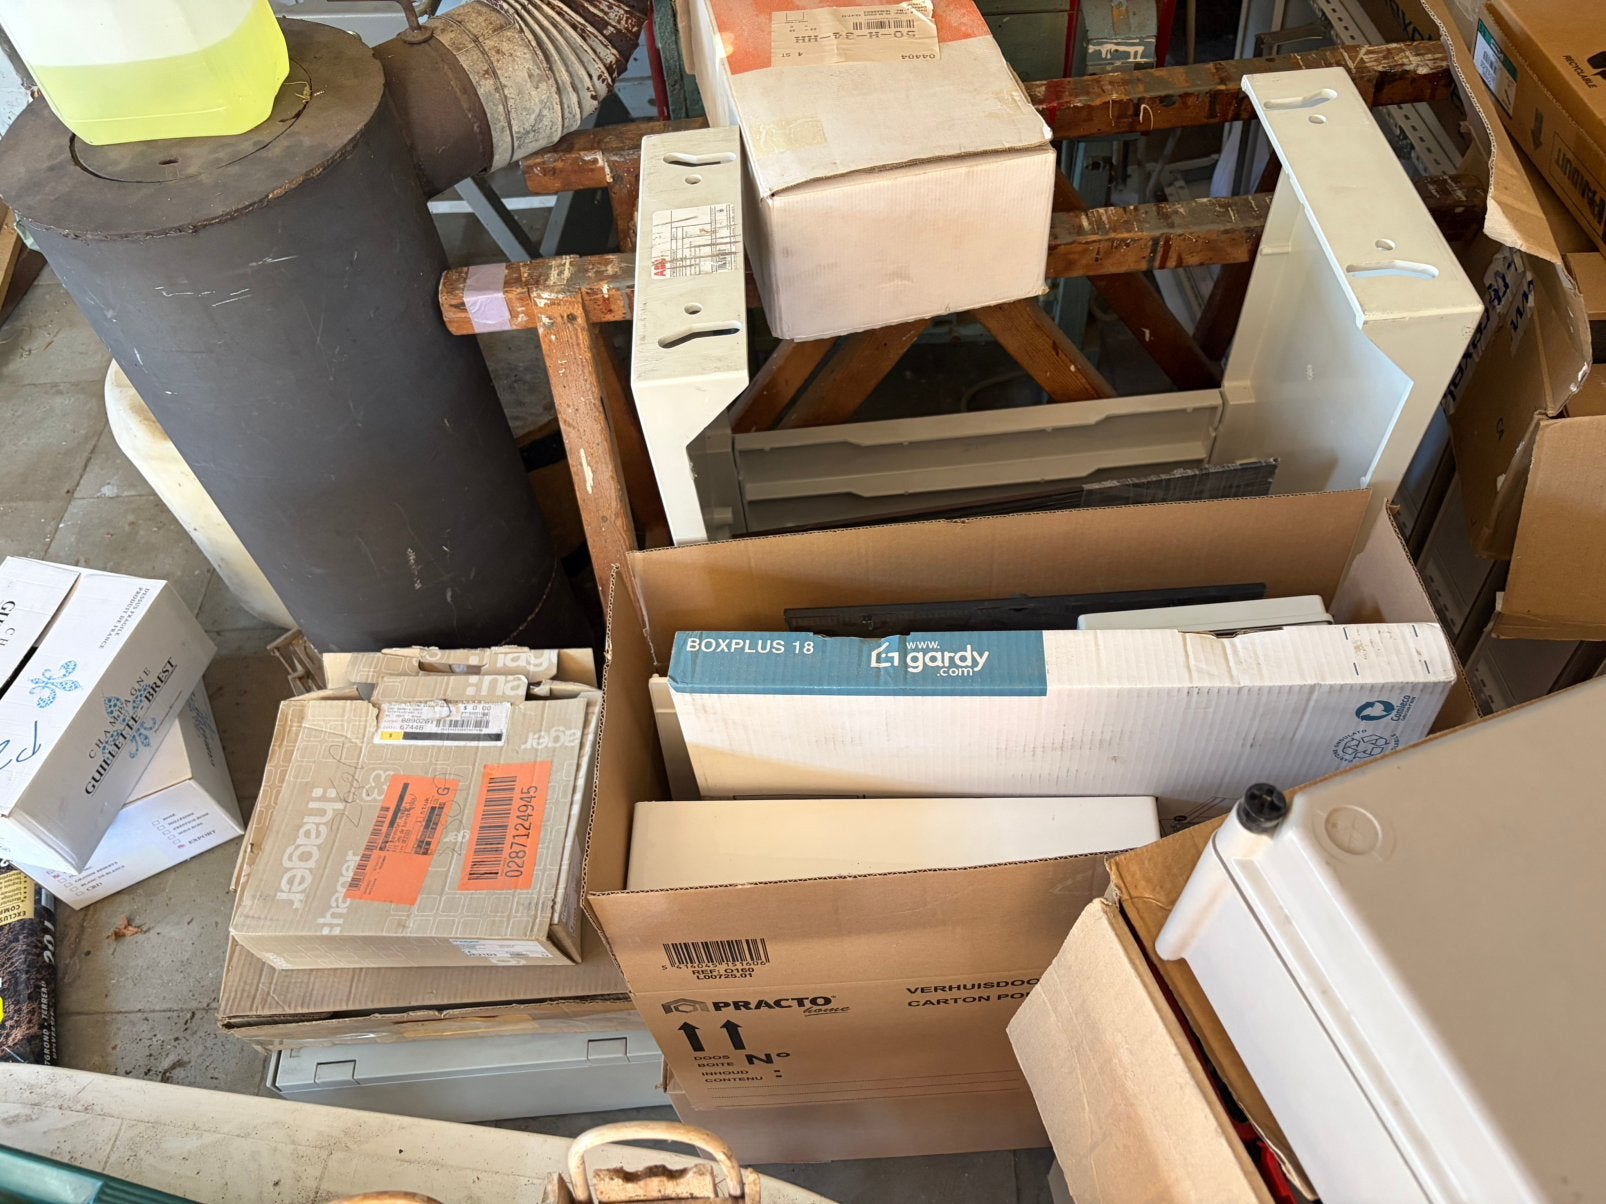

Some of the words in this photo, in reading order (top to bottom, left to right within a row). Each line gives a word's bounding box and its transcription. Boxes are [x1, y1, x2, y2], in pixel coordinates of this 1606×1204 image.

[1562, 55, 1598, 89] RECYCLABLE
[686, 638, 785, 654] BOXPLUS
[793, 641, 814, 655] 18
[906, 641, 941, 650] www.
[906, 645, 989, 672] gardy
[936, 666, 973, 677] .com
[87, 665, 152, 760] CHAMPAGNE
[83, 711, 141, 796] GUILLETTE
[144, 656, 177, 704] BREST
[505, 785, 539, 879] 0287124945
[692, 968, 721, 976] REF:
[696, 972, 753, 981] L00725.01
[713, 996, 833, 1012] PRACTO
[907, 995, 991, 1008] CARTON
[803, 1003, 851, 1014] home
[693, 1054, 730, 1062] DOOS
[697, 1060, 735, 1068] BOITE
[702, 1069, 749, 1077] INHOUD
[705, 1075, 763, 1083] CONTENU
